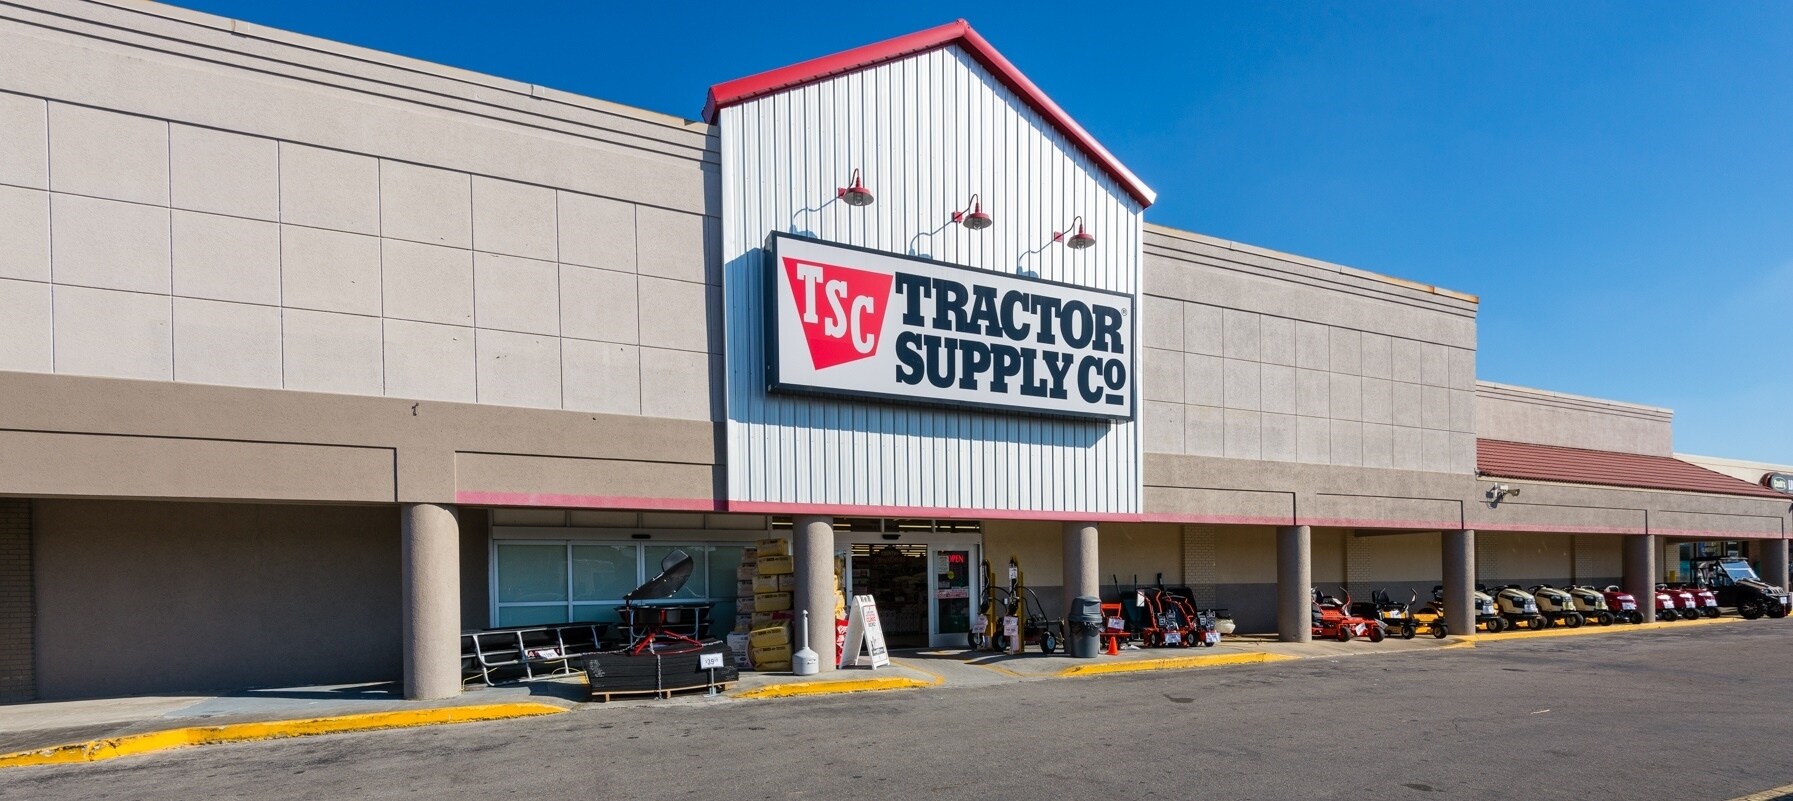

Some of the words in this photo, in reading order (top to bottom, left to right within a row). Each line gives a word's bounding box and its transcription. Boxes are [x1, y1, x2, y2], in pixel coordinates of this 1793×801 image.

[797, 263, 875, 355] TSC
[895, 271, 1125, 355] TRACTOR
[895, 330, 1074, 400] SUPPLY
[947, 554, 964, 564] OPEN
